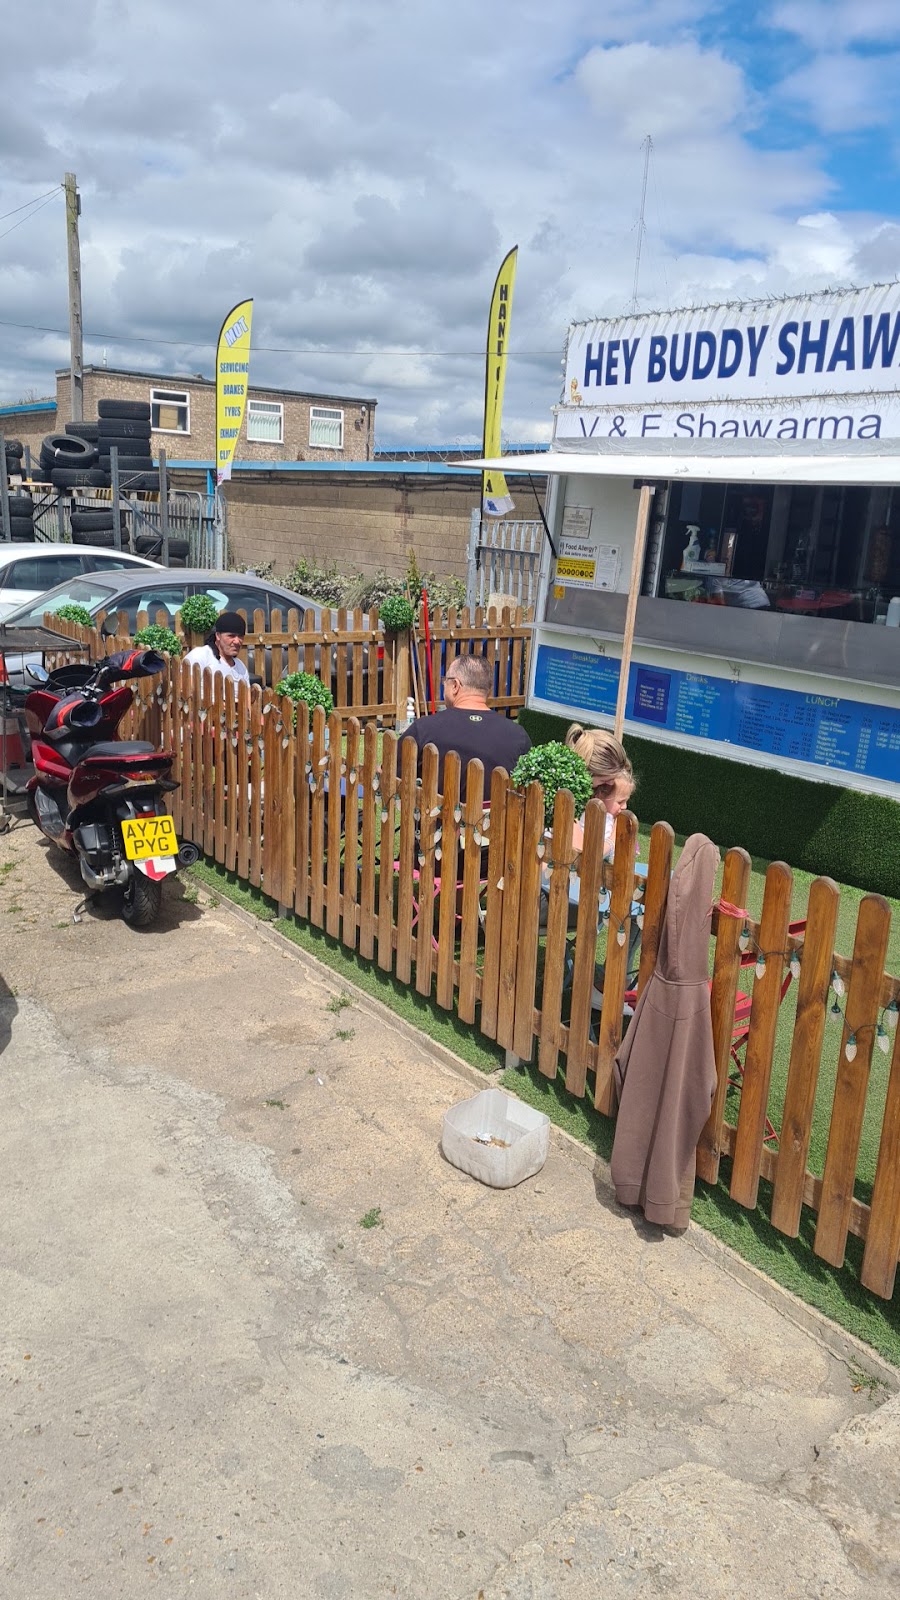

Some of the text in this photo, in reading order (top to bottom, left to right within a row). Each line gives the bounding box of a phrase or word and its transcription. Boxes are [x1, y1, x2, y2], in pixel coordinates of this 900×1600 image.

[497, 284, 508, 357] HAND
[224, 315, 249, 347] MOT
[583, 311, 900, 387] HEY BUDDY SHAW
[220, 362, 249, 373] SERVICING
[223, 384, 245, 395] BRAKES
[224, 406, 241, 417] TYRES
[579, 416, 600, 437] V
[608, 414, 628, 437] &
[673, 413, 882, 439] Shawarma
[565, 542, 578, 551] Food
[578, 544, 598, 553] Allergy?
[805, 695, 839, 708] LUNCH
[127, 820, 172, 839] AY70
[133, 837, 169, 855] PYG
